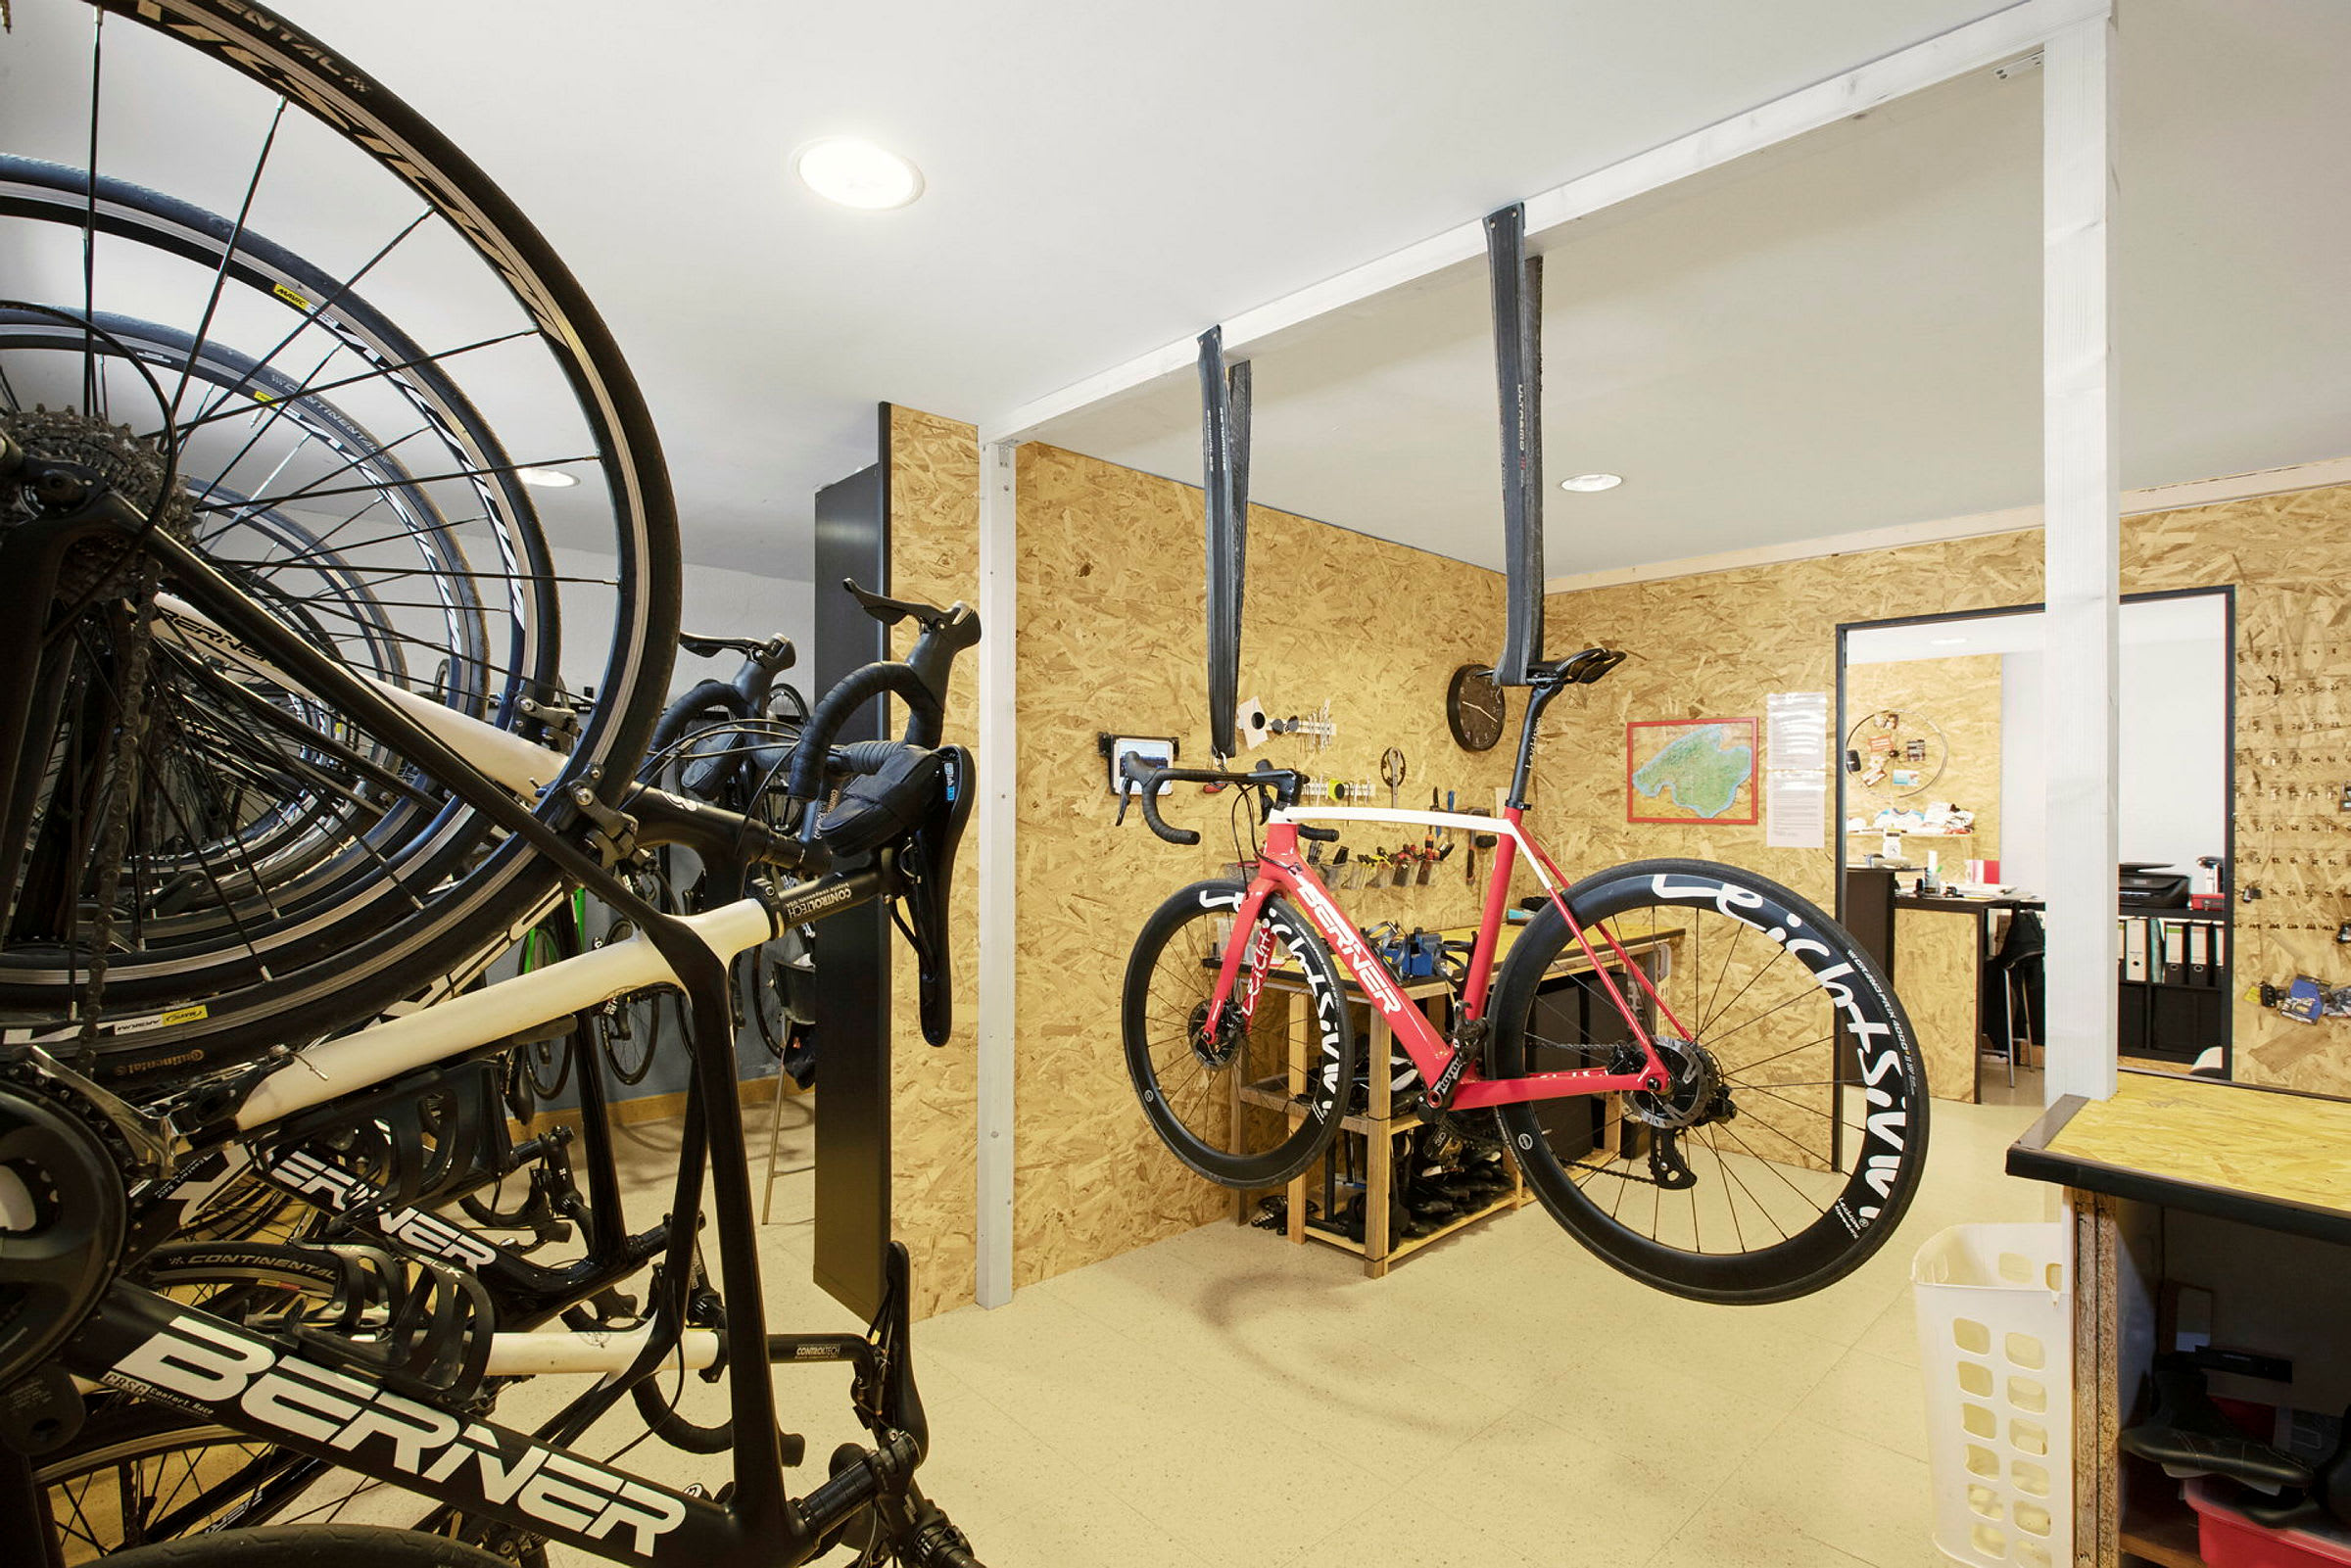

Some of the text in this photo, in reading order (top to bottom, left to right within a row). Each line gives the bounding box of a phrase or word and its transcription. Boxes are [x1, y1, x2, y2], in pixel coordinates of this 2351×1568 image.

[1296, 881, 1402, 1015] BERNER
[187, 1254, 337, 1278] CONTINENTAL
[112, 1314, 687, 1557] BERNER
